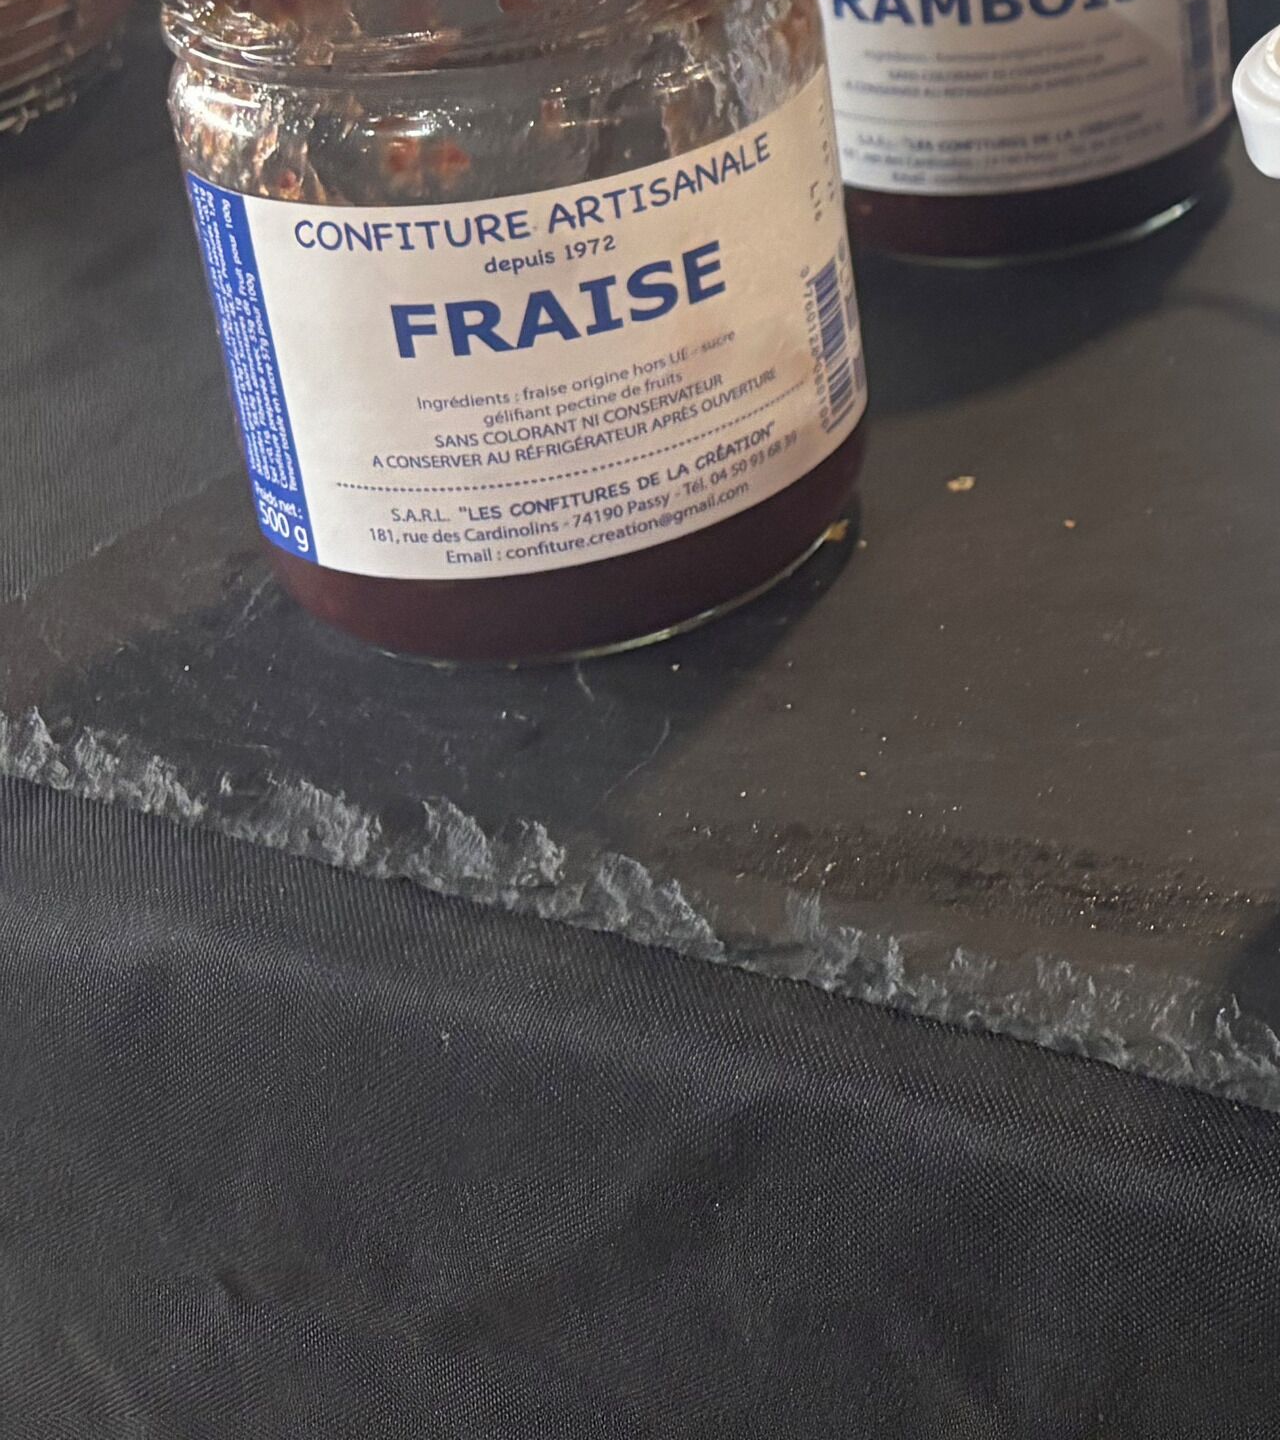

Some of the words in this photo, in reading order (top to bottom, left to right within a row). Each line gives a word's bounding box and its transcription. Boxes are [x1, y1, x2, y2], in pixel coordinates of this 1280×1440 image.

[295, 209, 531, 252] CONFITURE
[547, 132, 770, 234] ARTISANALE
[484, 250, 555, 276] depuis
[565, 234, 616, 261] 1972
[390, 240, 726, 358] FRAISE
[417, 391, 510, 413] Ingrédients
[523, 384, 567, 401] fraise
[572, 370, 629, 394] origine
[634, 358, 666, 376] hors
[435, 434, 478, 448] SANS
[484, 419, 577, 445] COLORANT
[583, 413, 600, 428] NI
[604, 374, 722, 423] CONSERVATEUR
[484, 405, 551, 428] gélifiant
[557, 392, 616, 417] pectine
[621, 385, 638, 399] de
[645, 371, 682, 392] fruits
[373, 456, 383, 468] A
[387, 454, 482, 469] CONSERVER
[487, 452, 510, 466] AU
[516, 421, 648, 461] RÉFRIGÉRATEUR
[702, 368, 776, 412] OUVERTURE
[370, 528, 400, 544] 181,
[403, 531, 428, 543] rue
[433, 529, 460, 542] des
[465, 520, 559, 542] Cardinolins
[573, 505, 623, 528] 74190
[628, 492, 670, 514] Passy
[391, 509, 451, 522] S.A.R.L.
[510, 481, 630, 517] CONFITURES
[638, 472, 660, 489] DE
[667, 464, 689, 481] LA
[446, 548, 492, 563] Email
[506, 481, 749, 559] confiture.creation@gmail.com
[259, 500, 290, 538] 500
[294, 525, 309, 552] g
